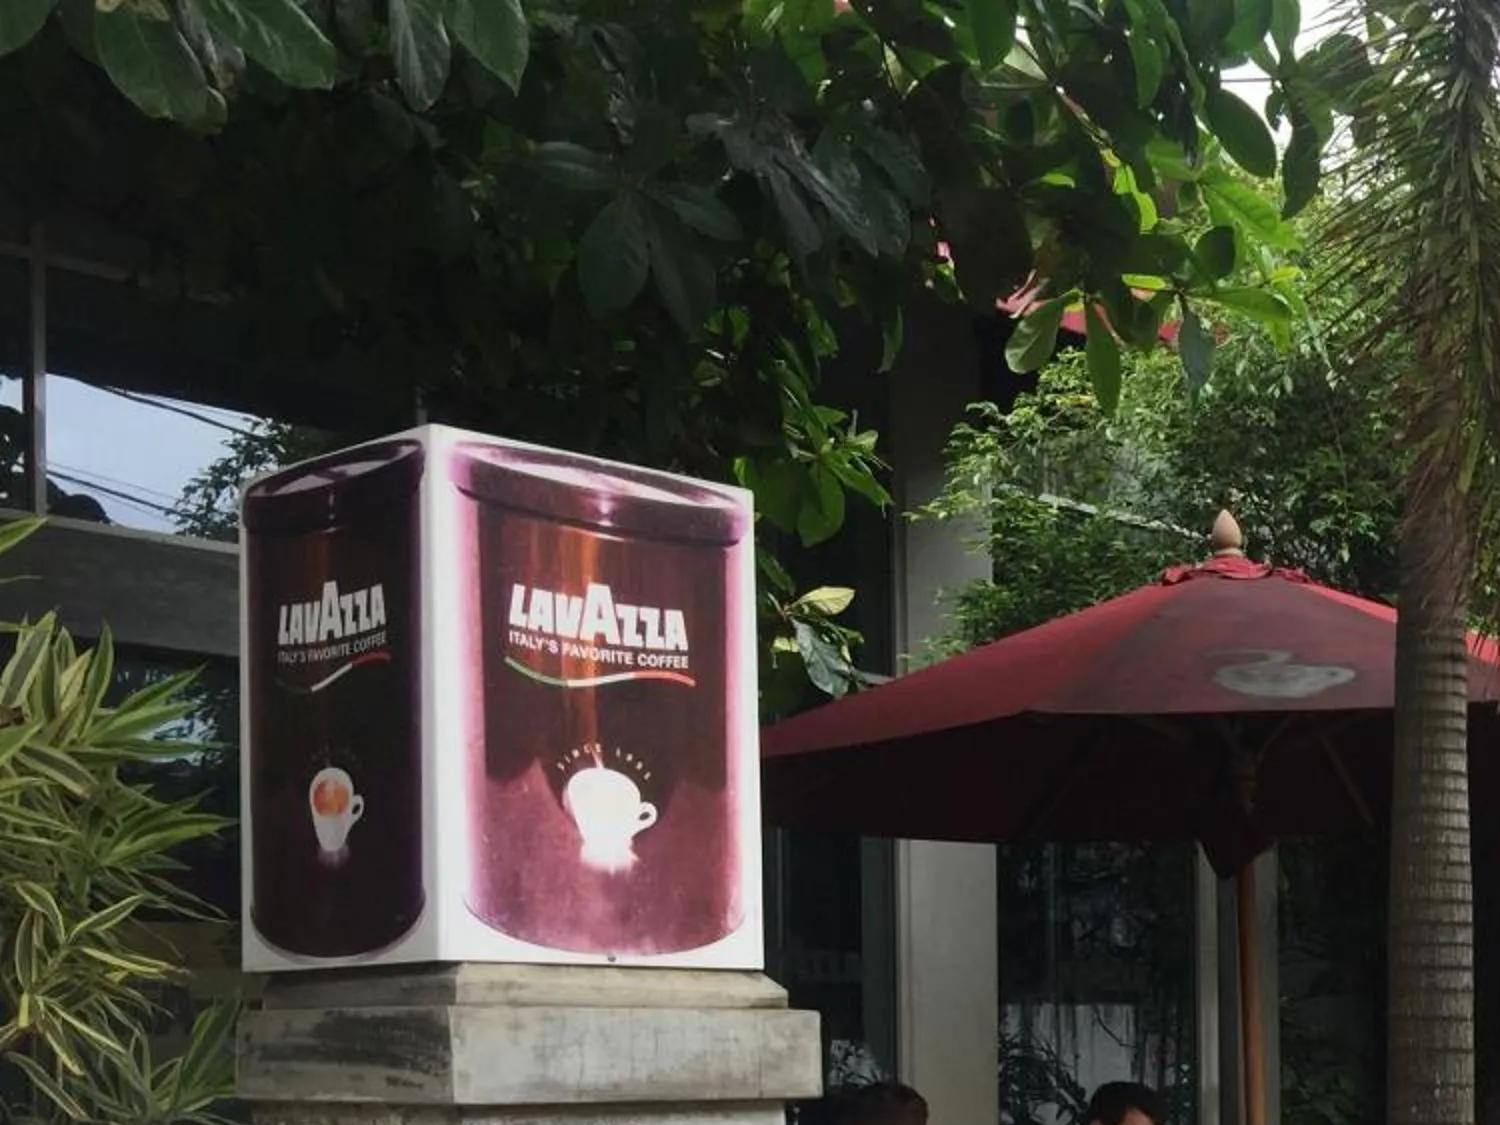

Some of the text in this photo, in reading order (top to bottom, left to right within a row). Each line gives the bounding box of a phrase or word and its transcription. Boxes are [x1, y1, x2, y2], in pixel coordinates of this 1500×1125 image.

[278, 580, 386, 645] LAVAZZA
[509, 582, 689, 651] LAVAZZA
[509, 630, 689, 669] ITALY'S FAVORITE COFFEE
